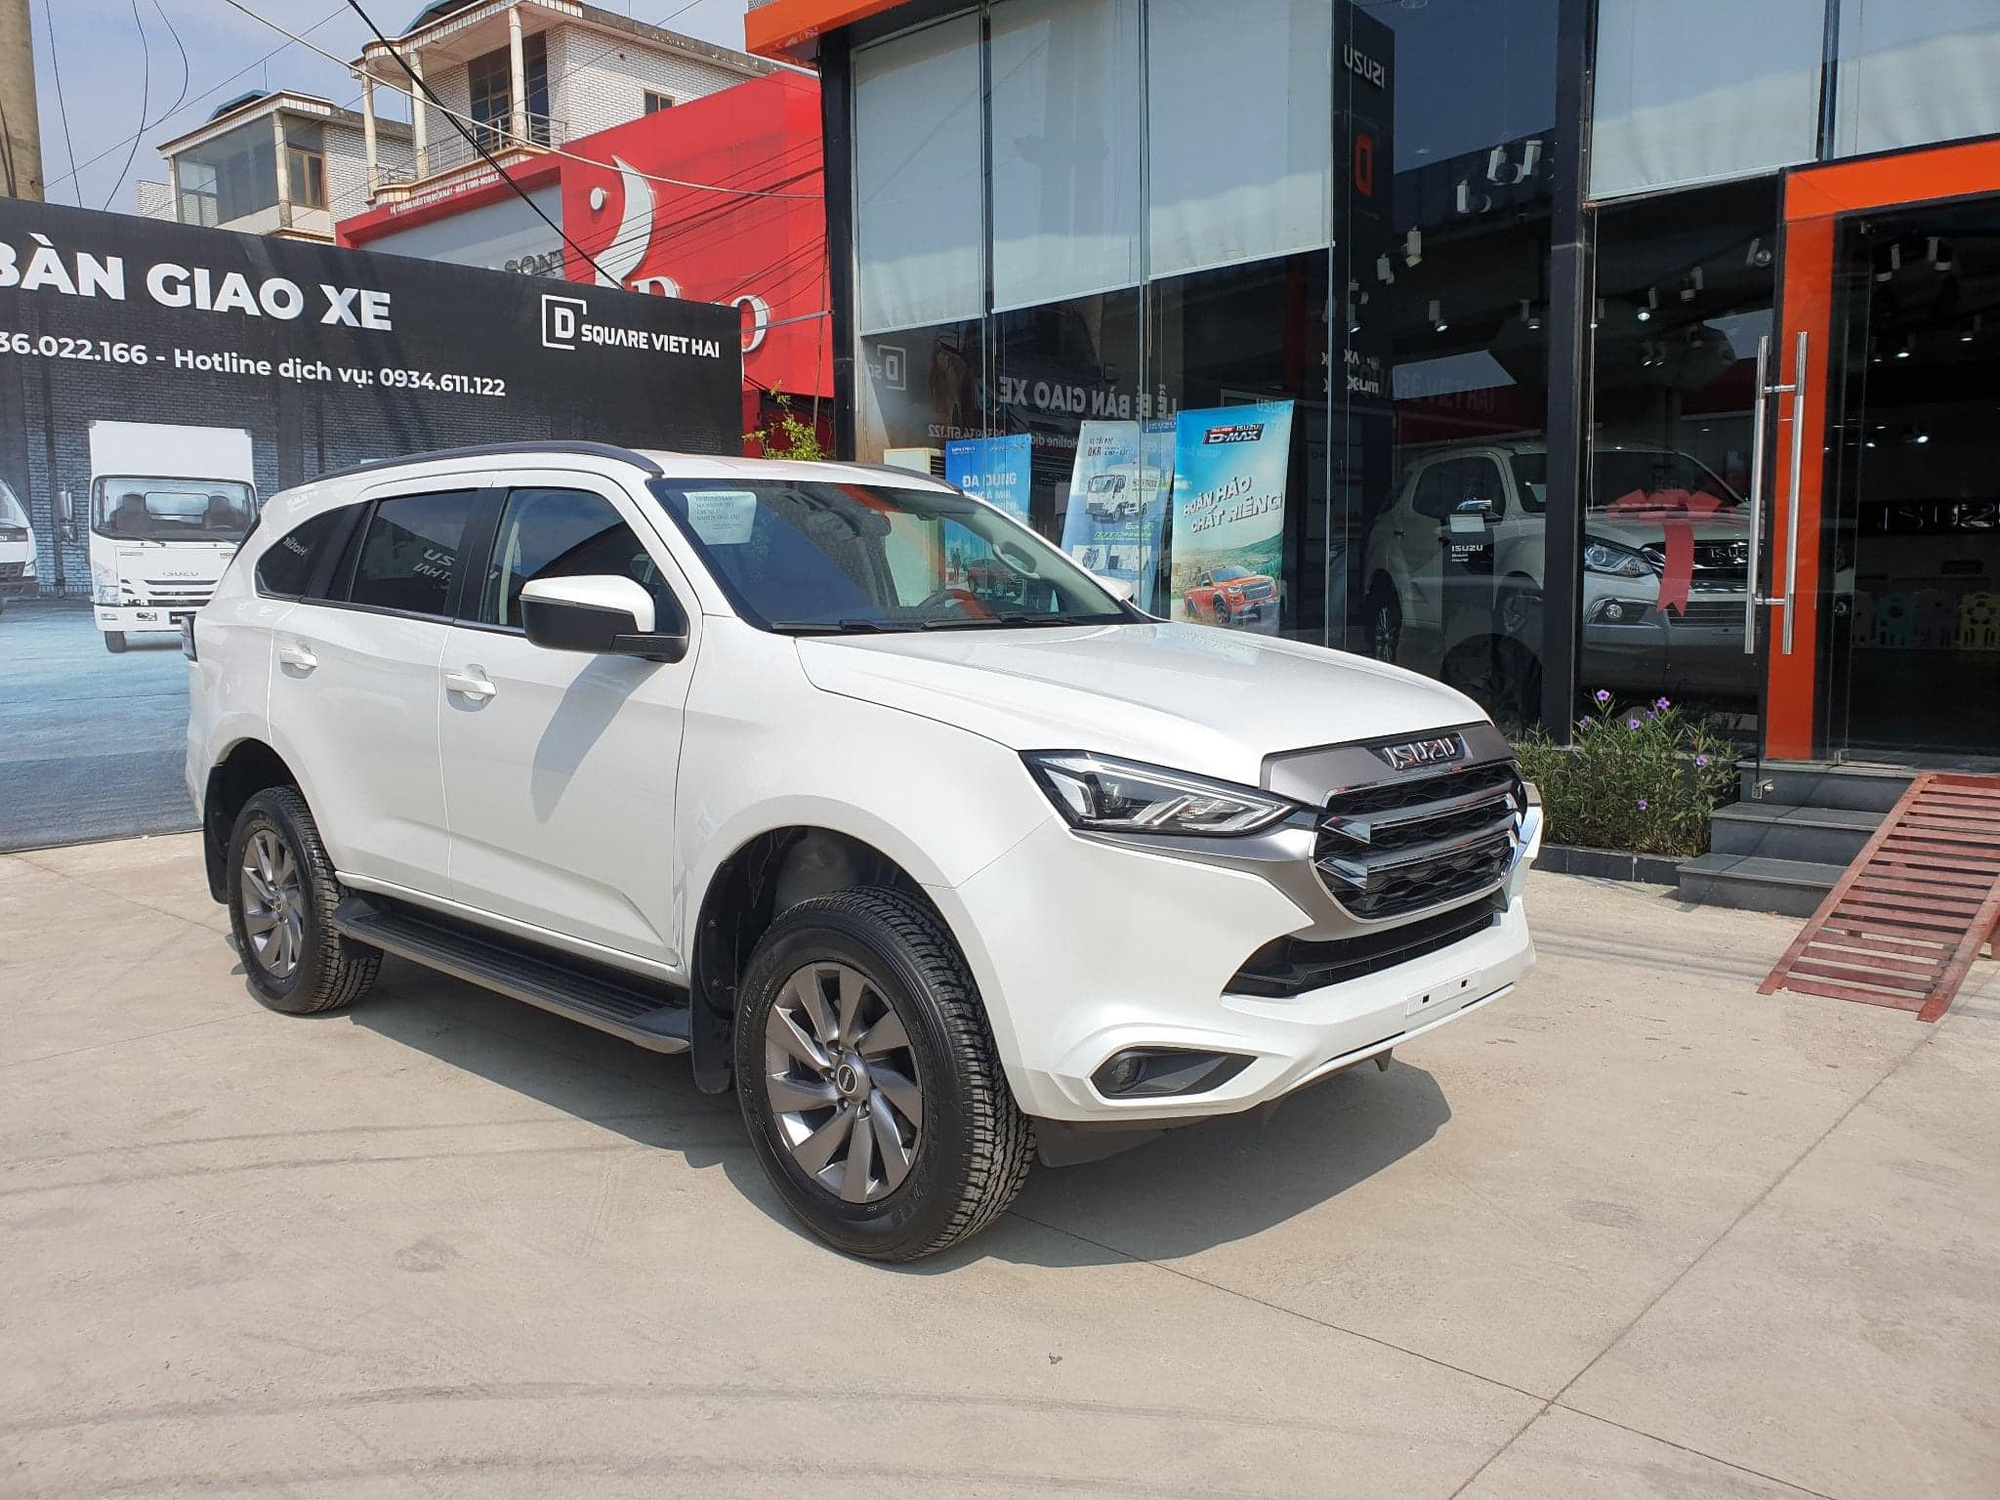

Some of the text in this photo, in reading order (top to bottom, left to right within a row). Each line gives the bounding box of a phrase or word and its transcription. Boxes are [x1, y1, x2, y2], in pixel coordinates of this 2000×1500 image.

[146, 262, 304, 320] GIAO
[319, 284, 392, 331] XE
[581, 324, 650, 349] SQUARE
[651, 333, 689, 354] VIET
[691, 338, 720, 358] HAI
[174, 348, 271, 376] Hotline
[279, 358, 332, 384] dịch
[338, 367, 373, 389] vụ:
[379, 368, 506, 397] 0934.611.122
[1209, 431, 1259, 444] D-MAX
[1236, 424, 1259, 432] ISUZU
[1884, 503, 2000, 532] ISUZ
[1451, 544, 1484, 552] ISUZU
[1384, 738, 1456, 769] ISUZU
